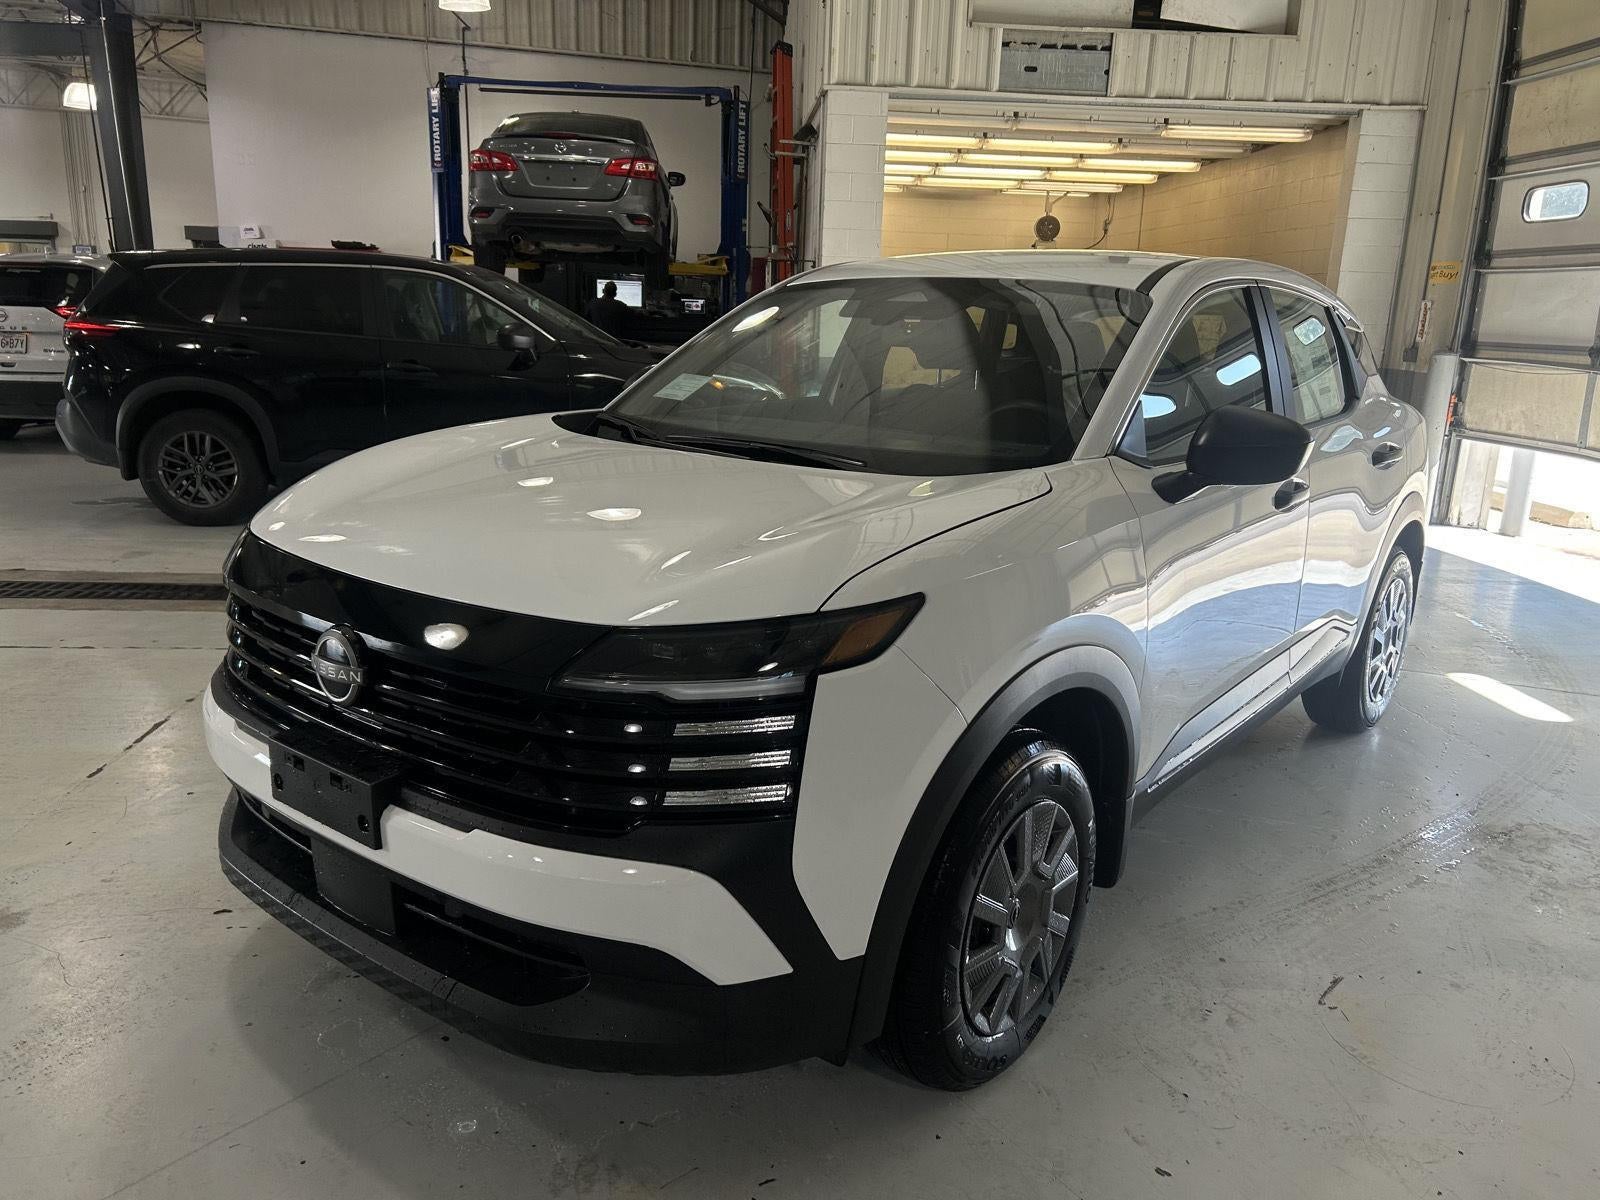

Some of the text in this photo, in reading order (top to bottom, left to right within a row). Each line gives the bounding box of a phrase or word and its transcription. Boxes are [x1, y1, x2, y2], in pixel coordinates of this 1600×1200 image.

[432, 116, 441, 161] ROTARY
[737, 102, 746, 173] ROTARY LIFT
